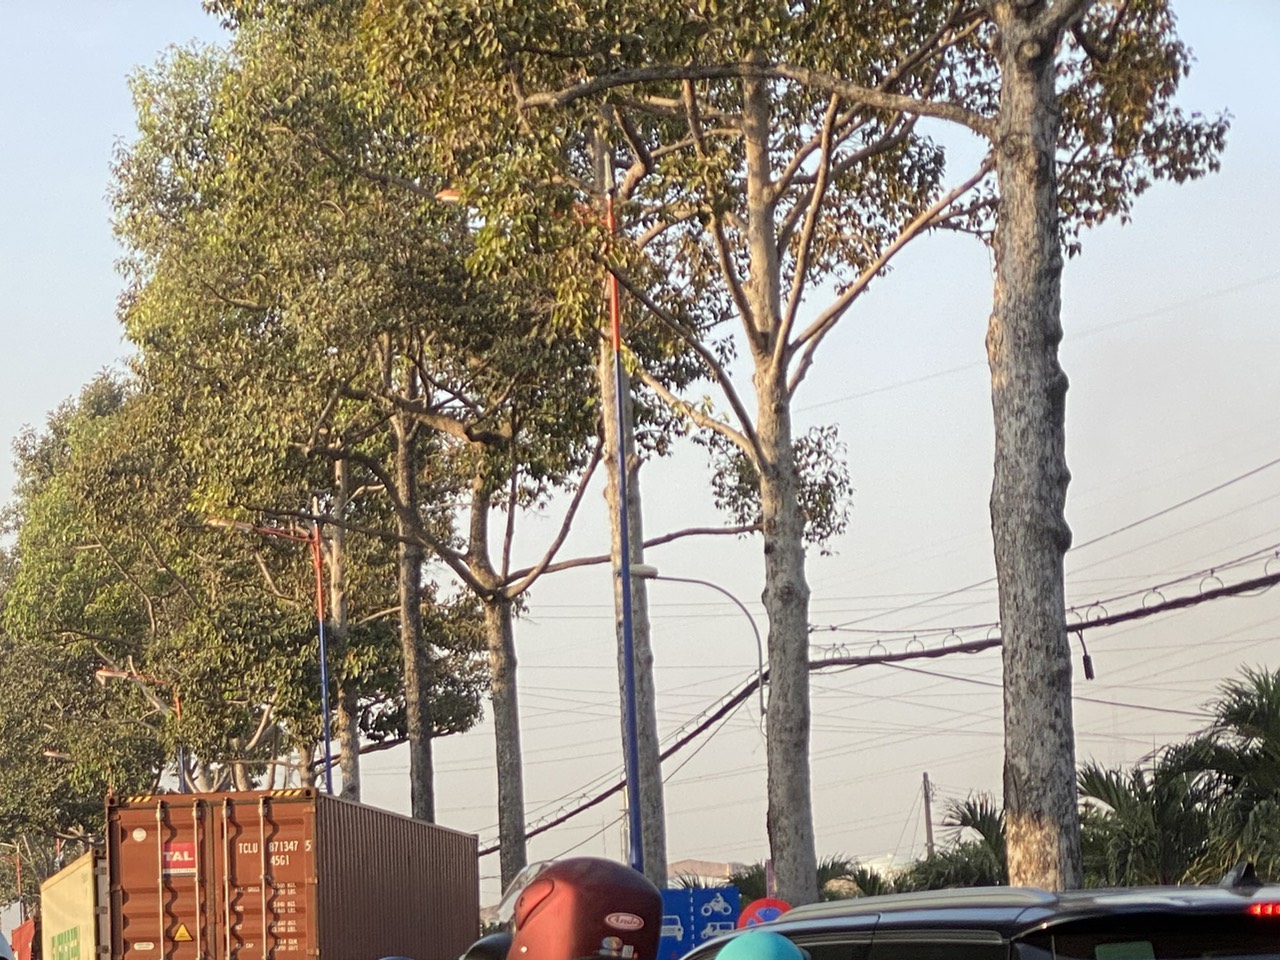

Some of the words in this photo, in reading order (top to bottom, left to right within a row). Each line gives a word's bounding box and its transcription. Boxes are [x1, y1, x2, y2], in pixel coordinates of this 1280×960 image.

[238, 843, 258, 854] TCLU
[269, 841, 298, 852] 871347
[305, 840, 312, 851] 5
[163, 851, 194, 861] TAL
[270, 855, 290, 866] 45G1
